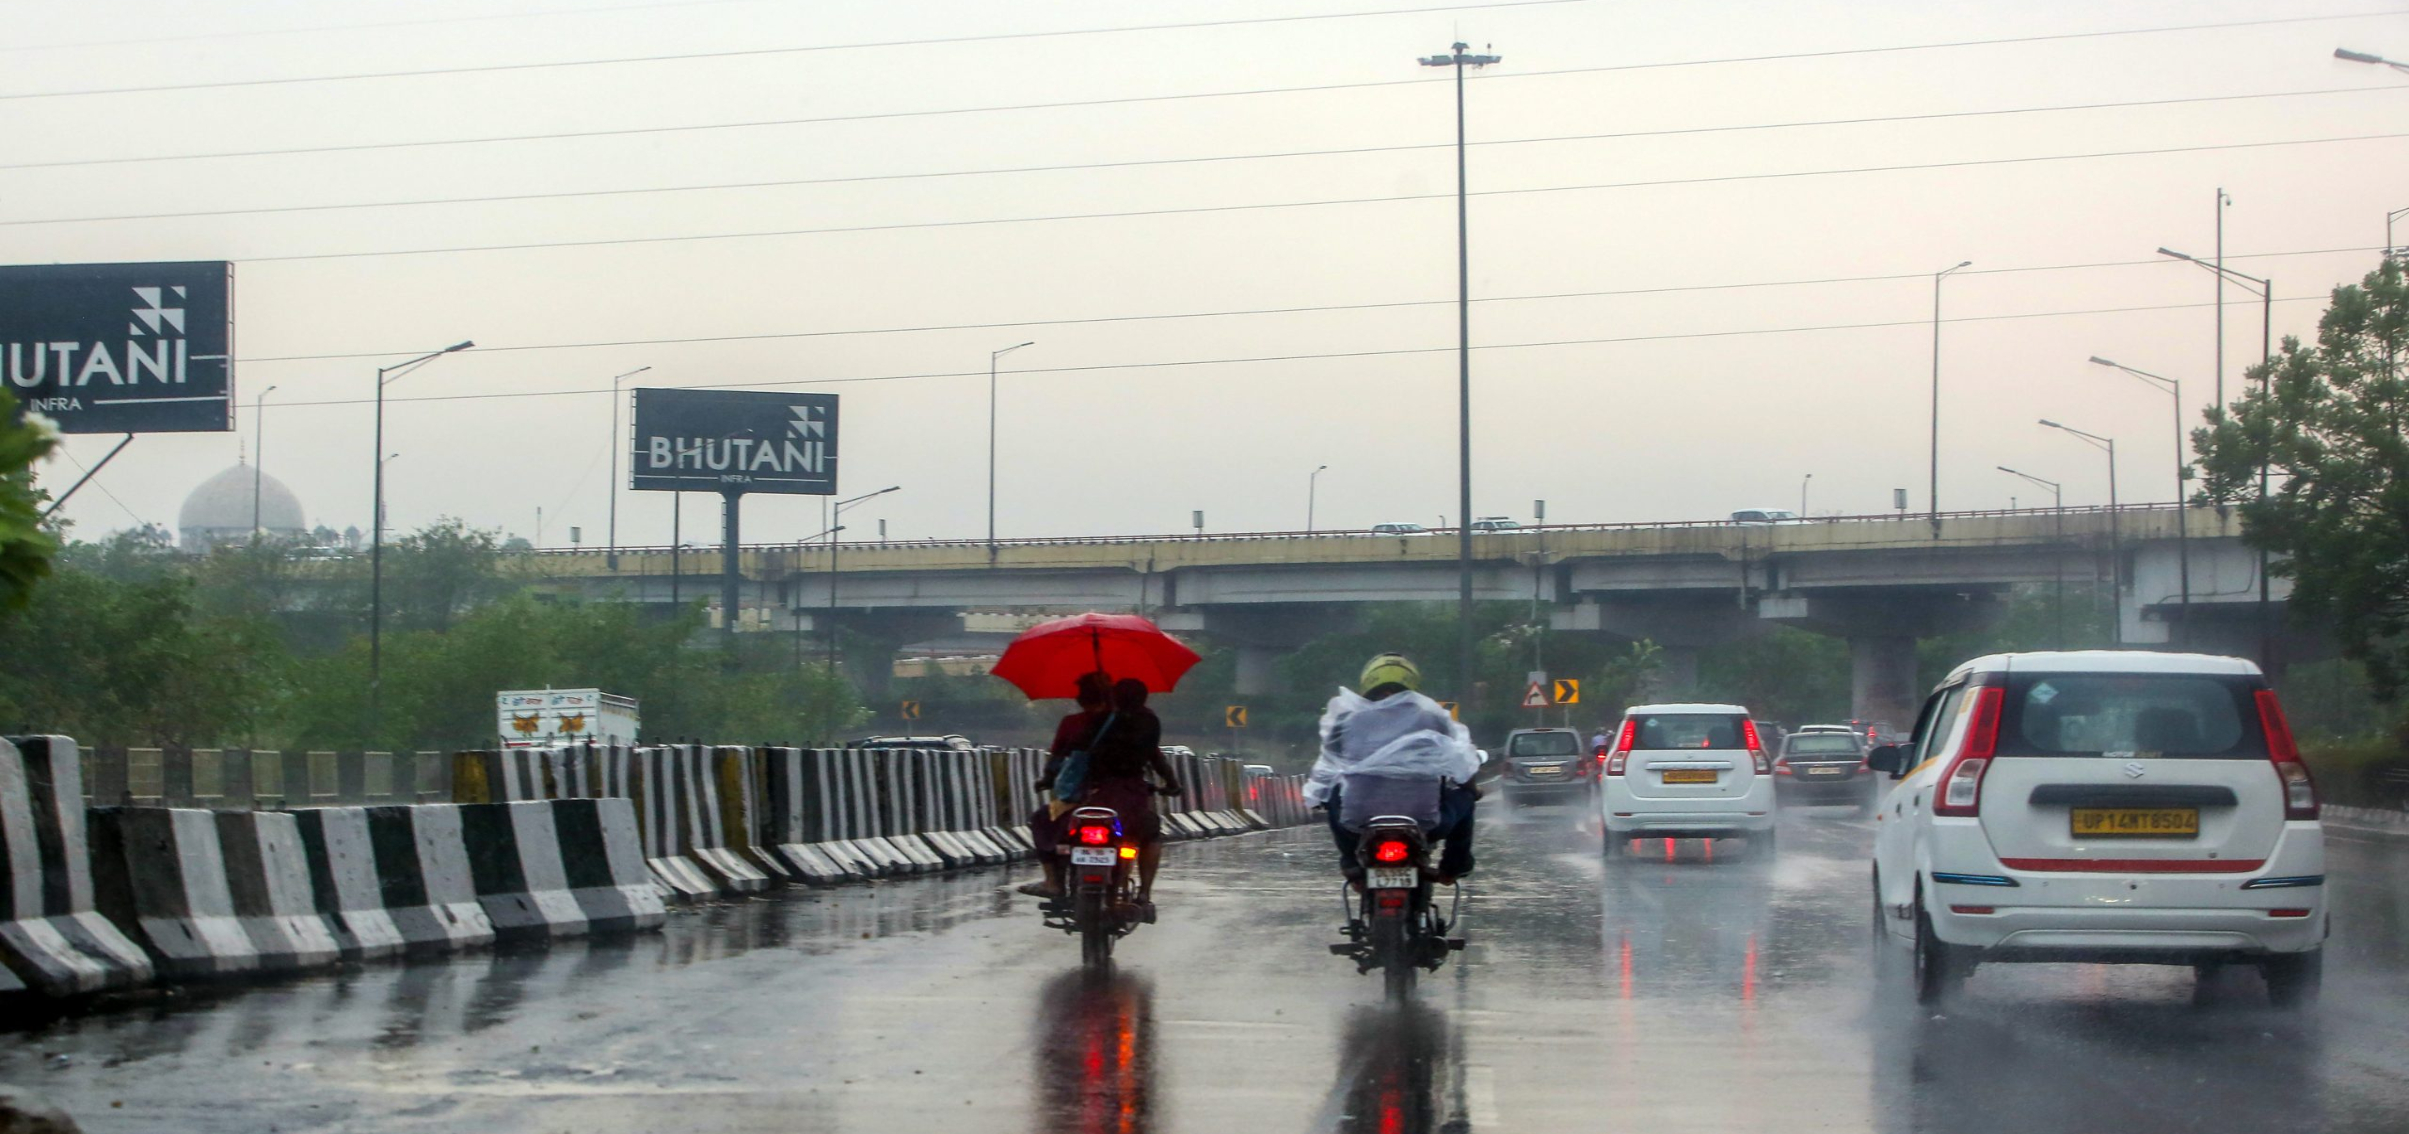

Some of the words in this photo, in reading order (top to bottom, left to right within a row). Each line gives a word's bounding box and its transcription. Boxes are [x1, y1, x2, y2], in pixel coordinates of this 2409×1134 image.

[0, 339, 186, 387] UTANI
[31, 398, 82, 412] INFRA
[651, 436, 824, 473] BHUTANI
[721, 474, 752, 484] INFRA
